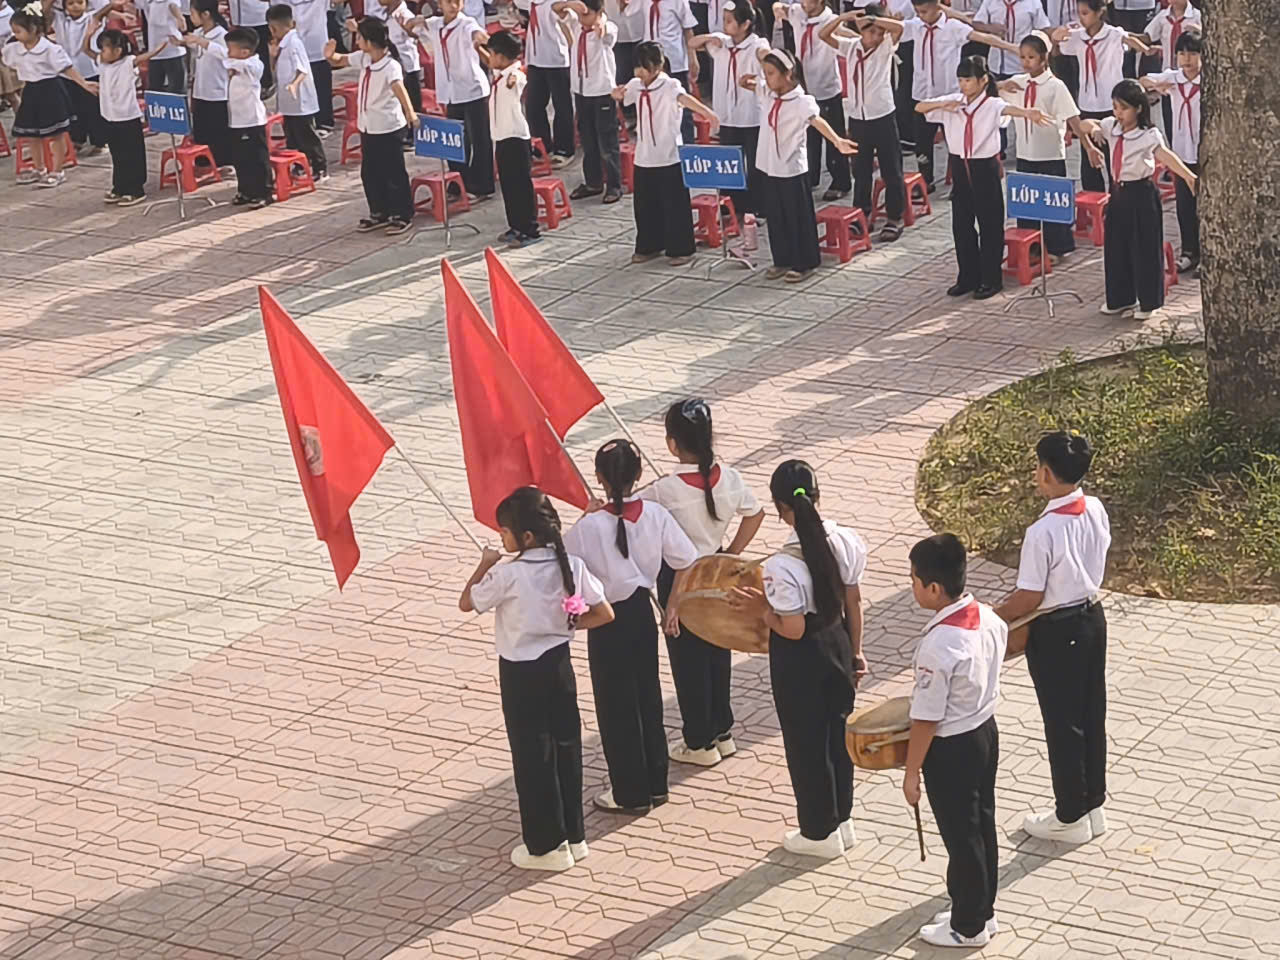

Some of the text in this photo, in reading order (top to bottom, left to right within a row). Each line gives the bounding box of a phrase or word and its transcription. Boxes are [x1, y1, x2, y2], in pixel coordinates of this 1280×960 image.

[148, 101, 167, 119] LỚP
[417, 125, 438, 143] LỚP
[685, 155, 739, 174] LỚP 4A7
[1011, 184, 1070, 208] LỚP 4A8
